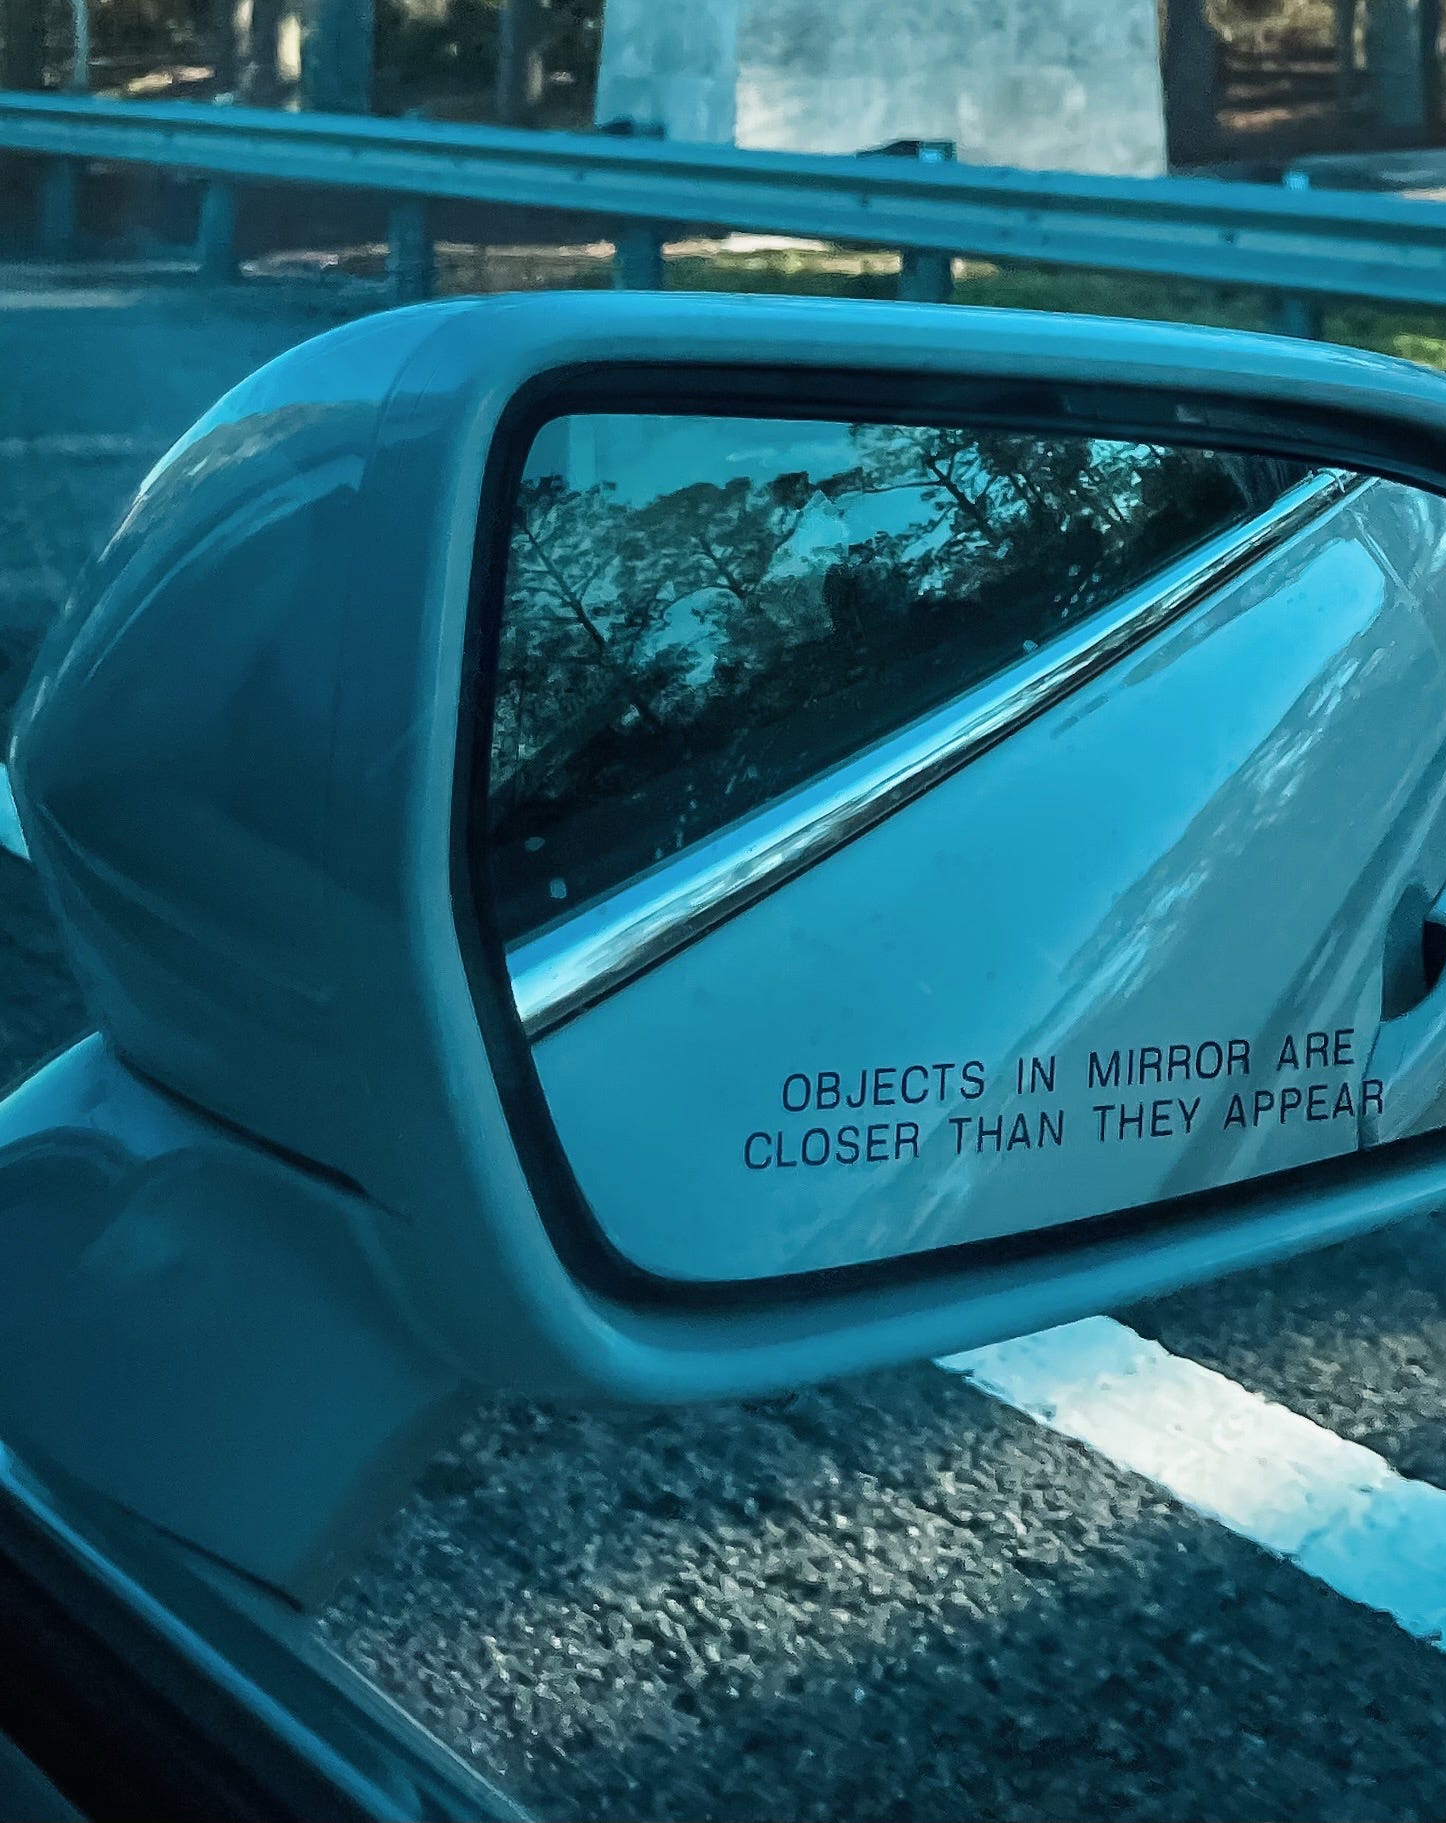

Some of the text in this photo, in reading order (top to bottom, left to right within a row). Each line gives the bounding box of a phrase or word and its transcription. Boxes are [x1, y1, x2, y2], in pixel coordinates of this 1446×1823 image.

[782, 1029, 1355, 1112] OBJECTS IN MIRROR ARE
[743, 1079, 1384, 1170] CLOSER THAN THEY APPEAR
